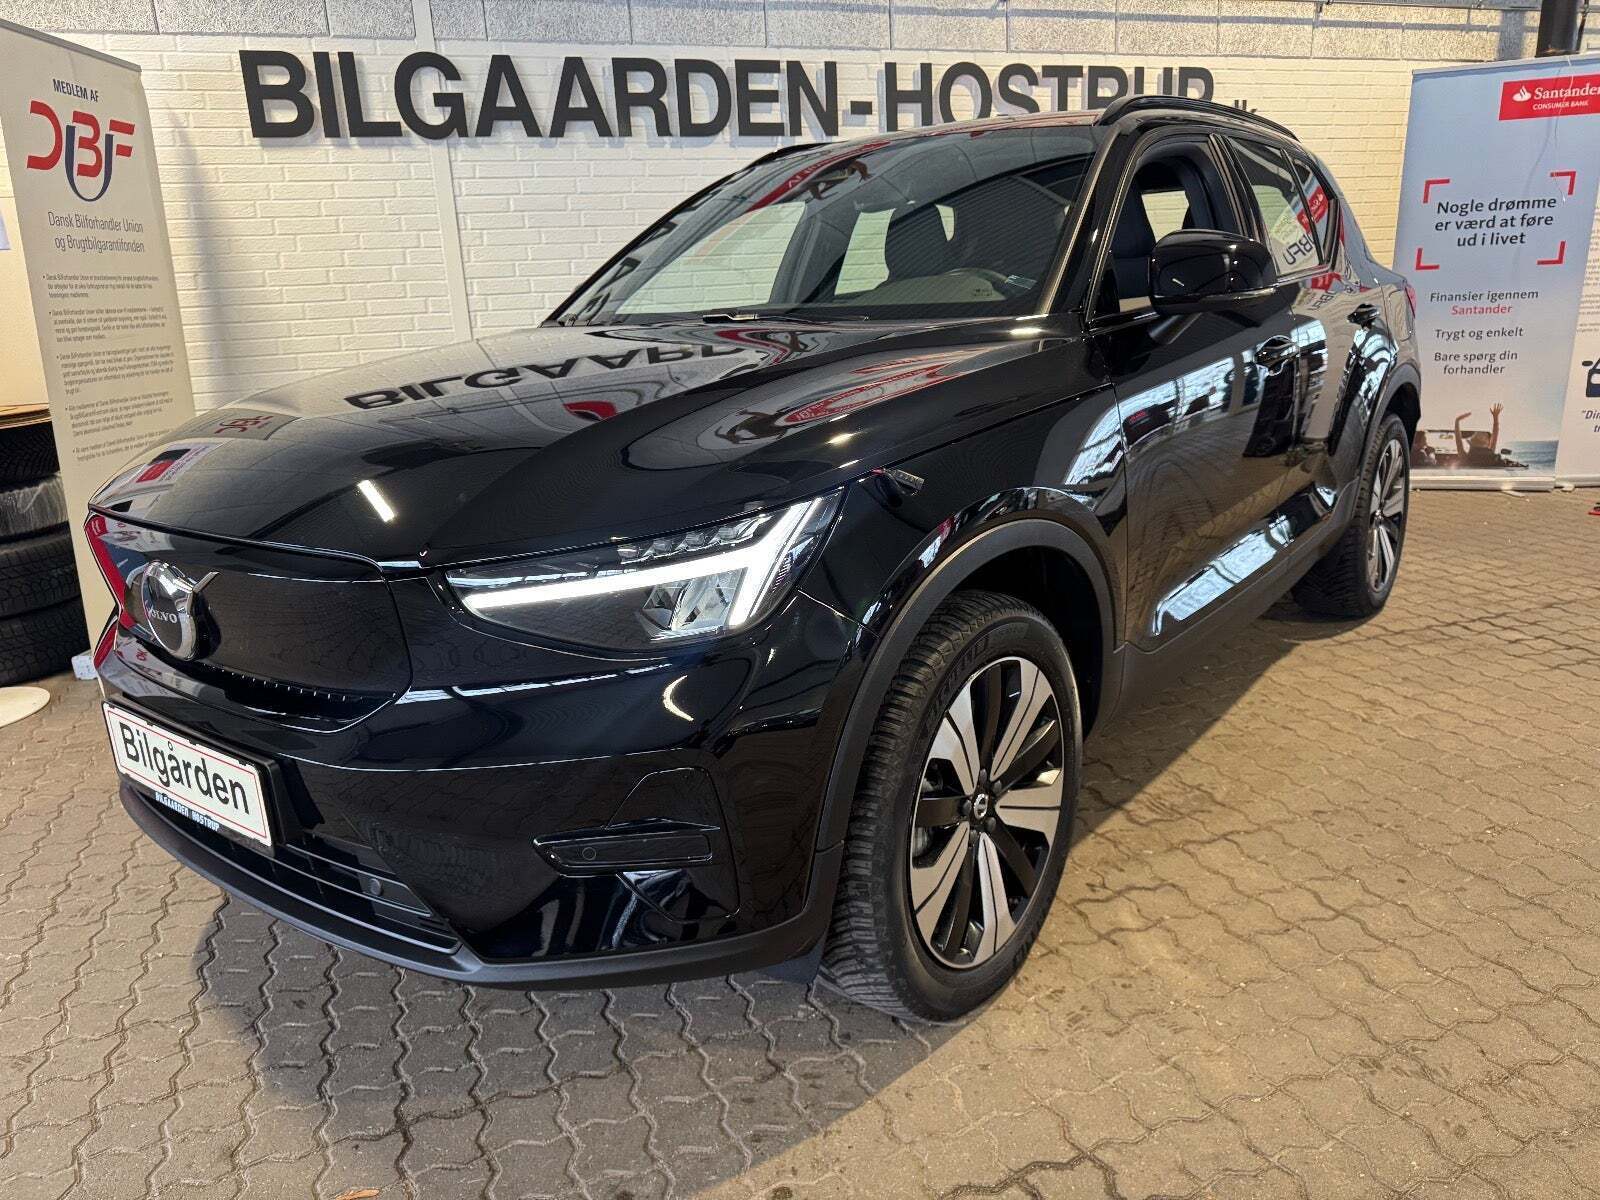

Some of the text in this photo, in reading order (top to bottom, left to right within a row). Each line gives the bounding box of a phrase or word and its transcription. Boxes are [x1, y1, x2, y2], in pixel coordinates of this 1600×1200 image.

[53, 79, 99, 102] MEDLEM AF
[1533, 82, 1600, 100] Santander
[1532, 99, 1589, 111] CONSUMER BANK
[1437, 197, 1557, 217] Nogle drømme
[48, 211, 144, 233] Dansk Bilforhandler Union
[1434, 213, 1554, 231] er værd at føre
[55, 234, 145, 253] og Brugtbilgarantifonden
[1457, 231, 1526, 247] ud i livet
[1430, 289, 1539, 303] Finansier igennem
[1451, 304, 1513, 316] Santander
[1435, 327, 1524, 341] Trygt og enkelt
[1434, 350, 1518, 365] Bare spørg din
[1443, 364, 1505, 375] forhandler
[145, 605, 178, 624] VOLVO
[119, 721, 250, 815] Bilgården
